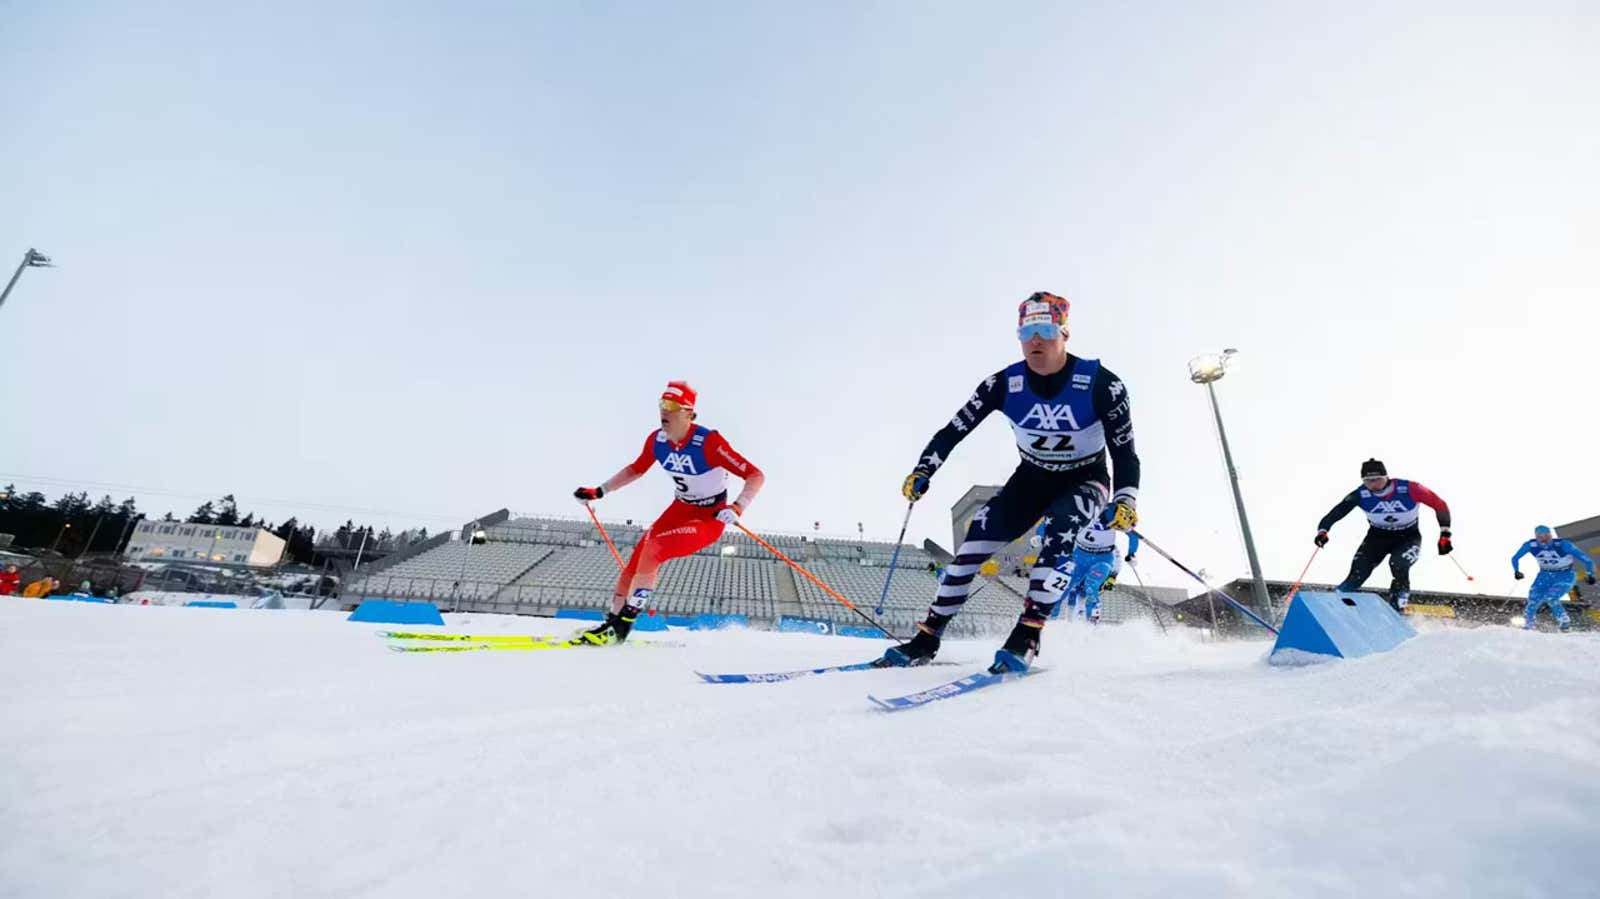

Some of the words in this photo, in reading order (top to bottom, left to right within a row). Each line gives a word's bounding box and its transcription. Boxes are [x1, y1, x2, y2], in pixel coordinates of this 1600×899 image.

[1018, 403, 1080, 430] AXA
[1027, 433, 1075, 451] 22
[662, 452, 697, 474] AXA
[672, 476, 689, 492] 5
[1370, 500, 1409, 513] AXA
[1051, 577, 1068, 591] 22
